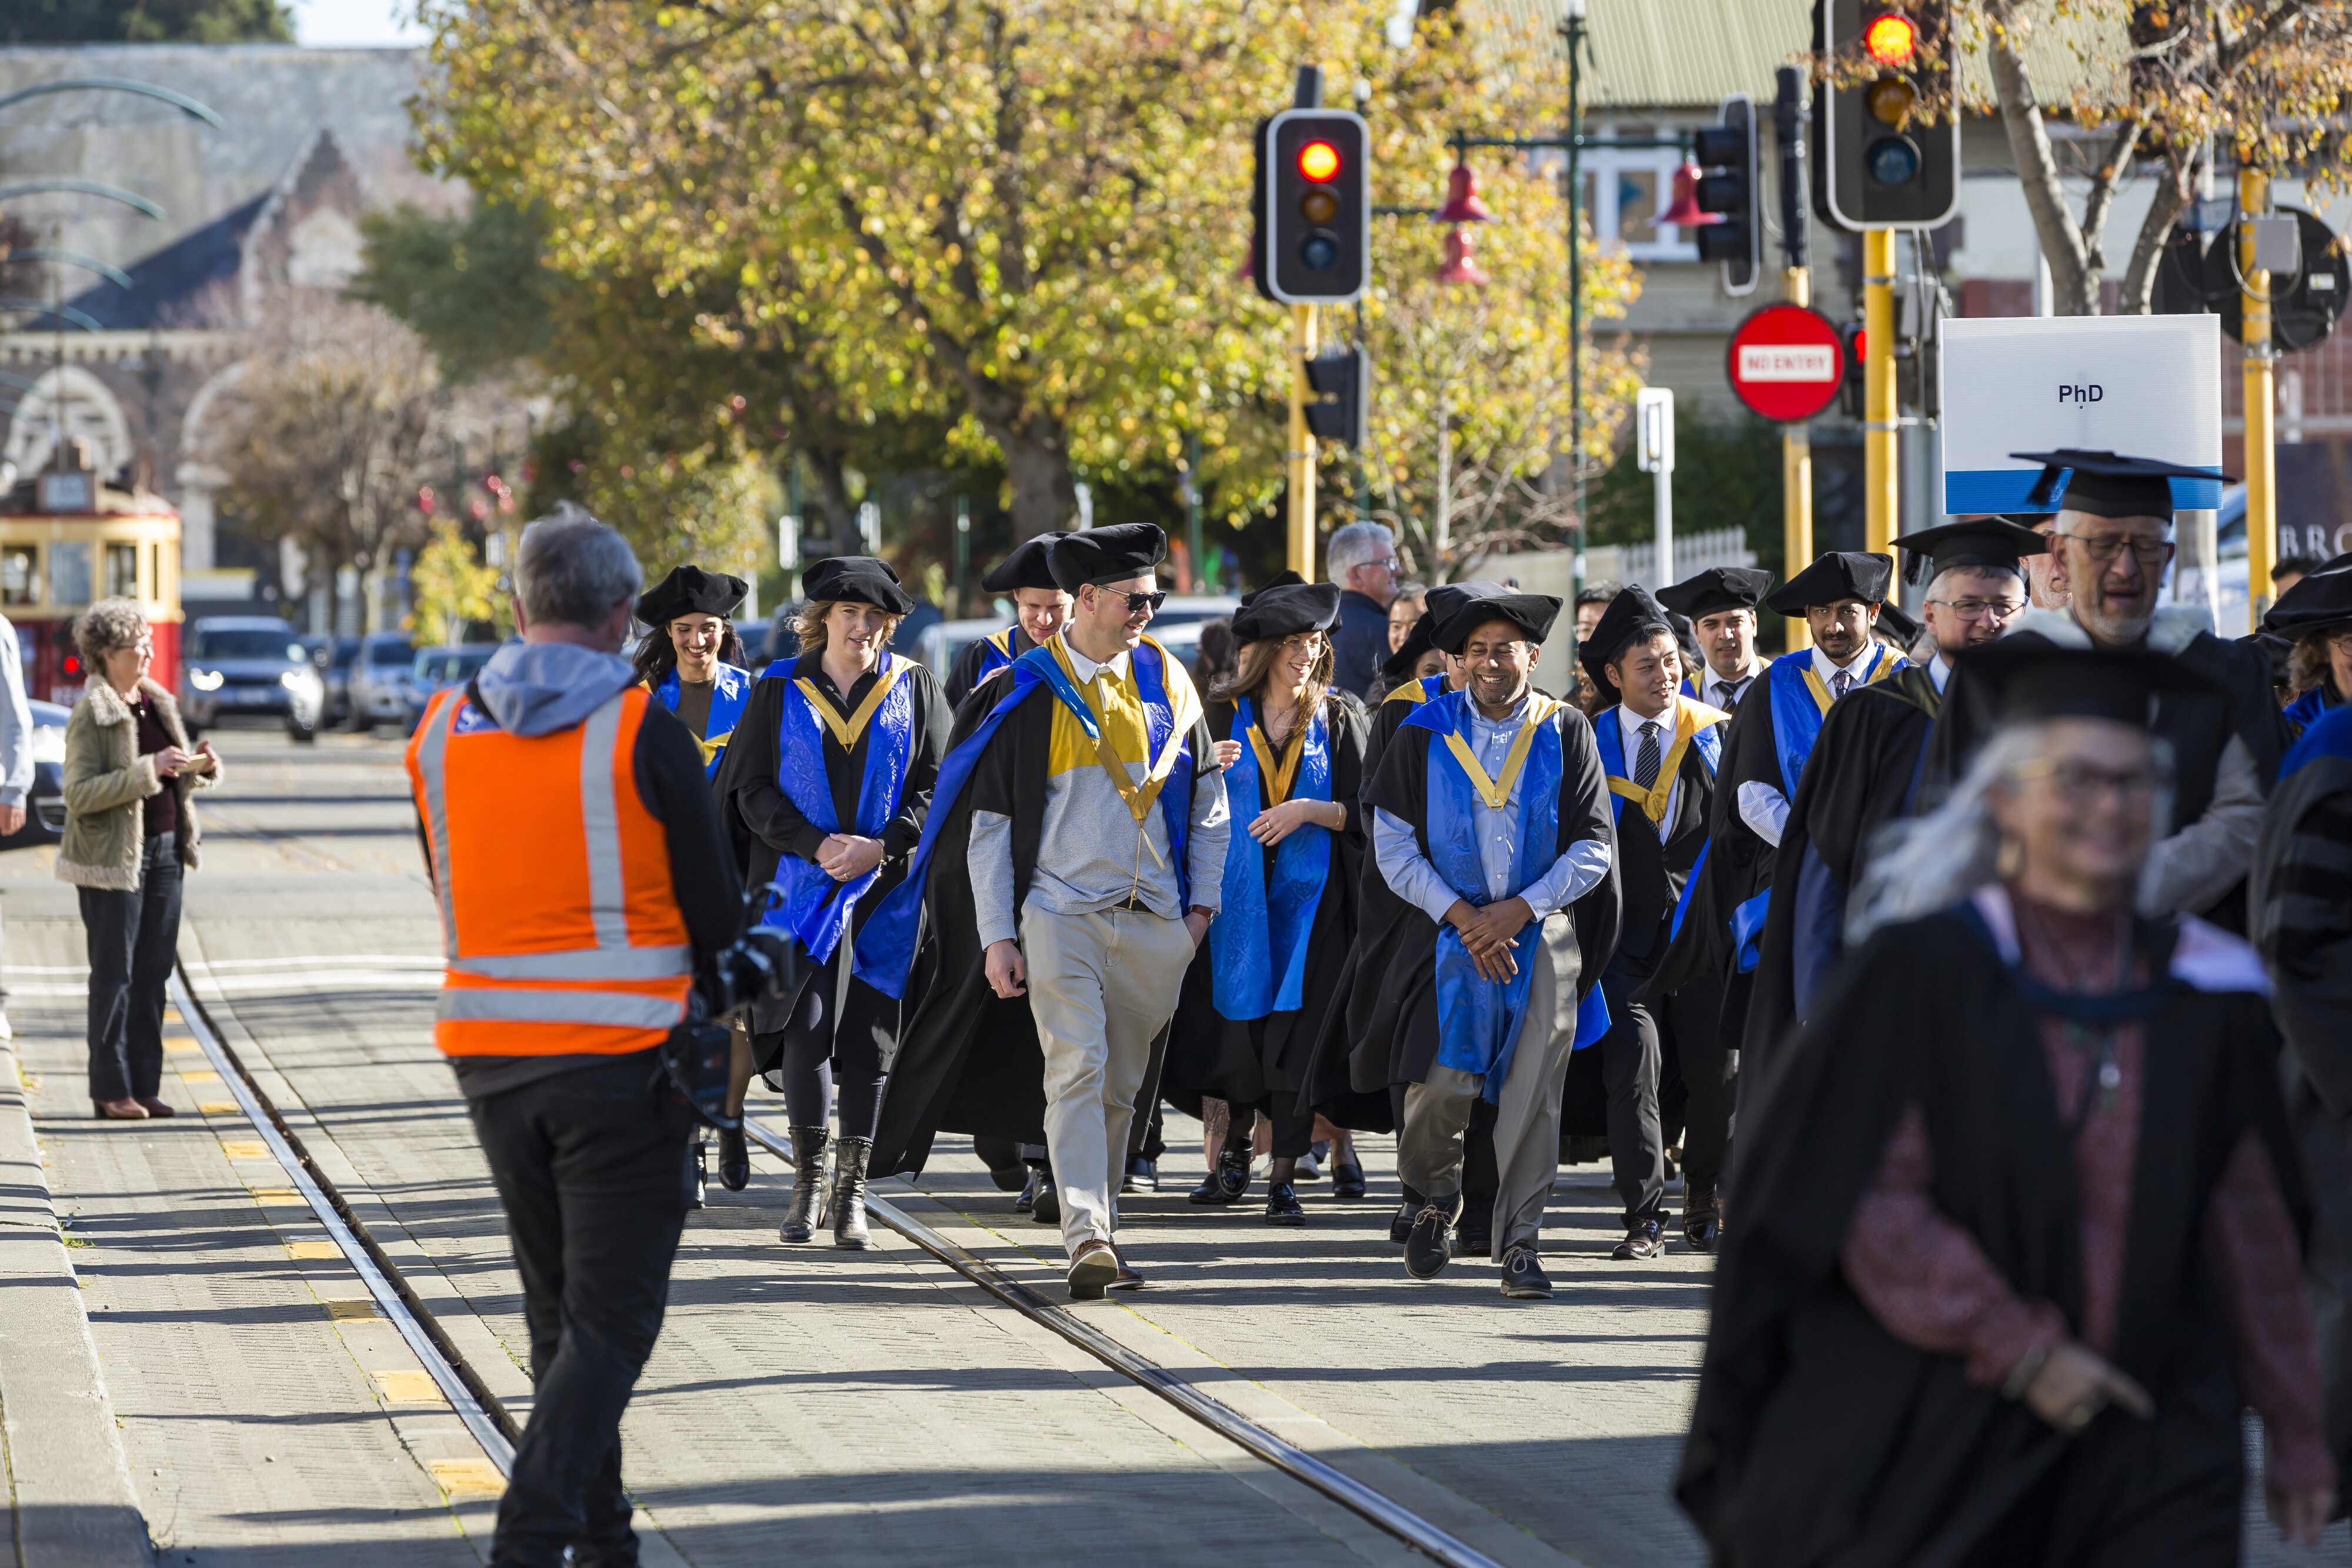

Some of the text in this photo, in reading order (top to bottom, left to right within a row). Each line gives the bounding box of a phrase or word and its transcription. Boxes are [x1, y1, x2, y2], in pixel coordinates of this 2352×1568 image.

[1747, 355, 1827, 369] NO ENTRY
[2059, 385, 2103, 402] PhD
